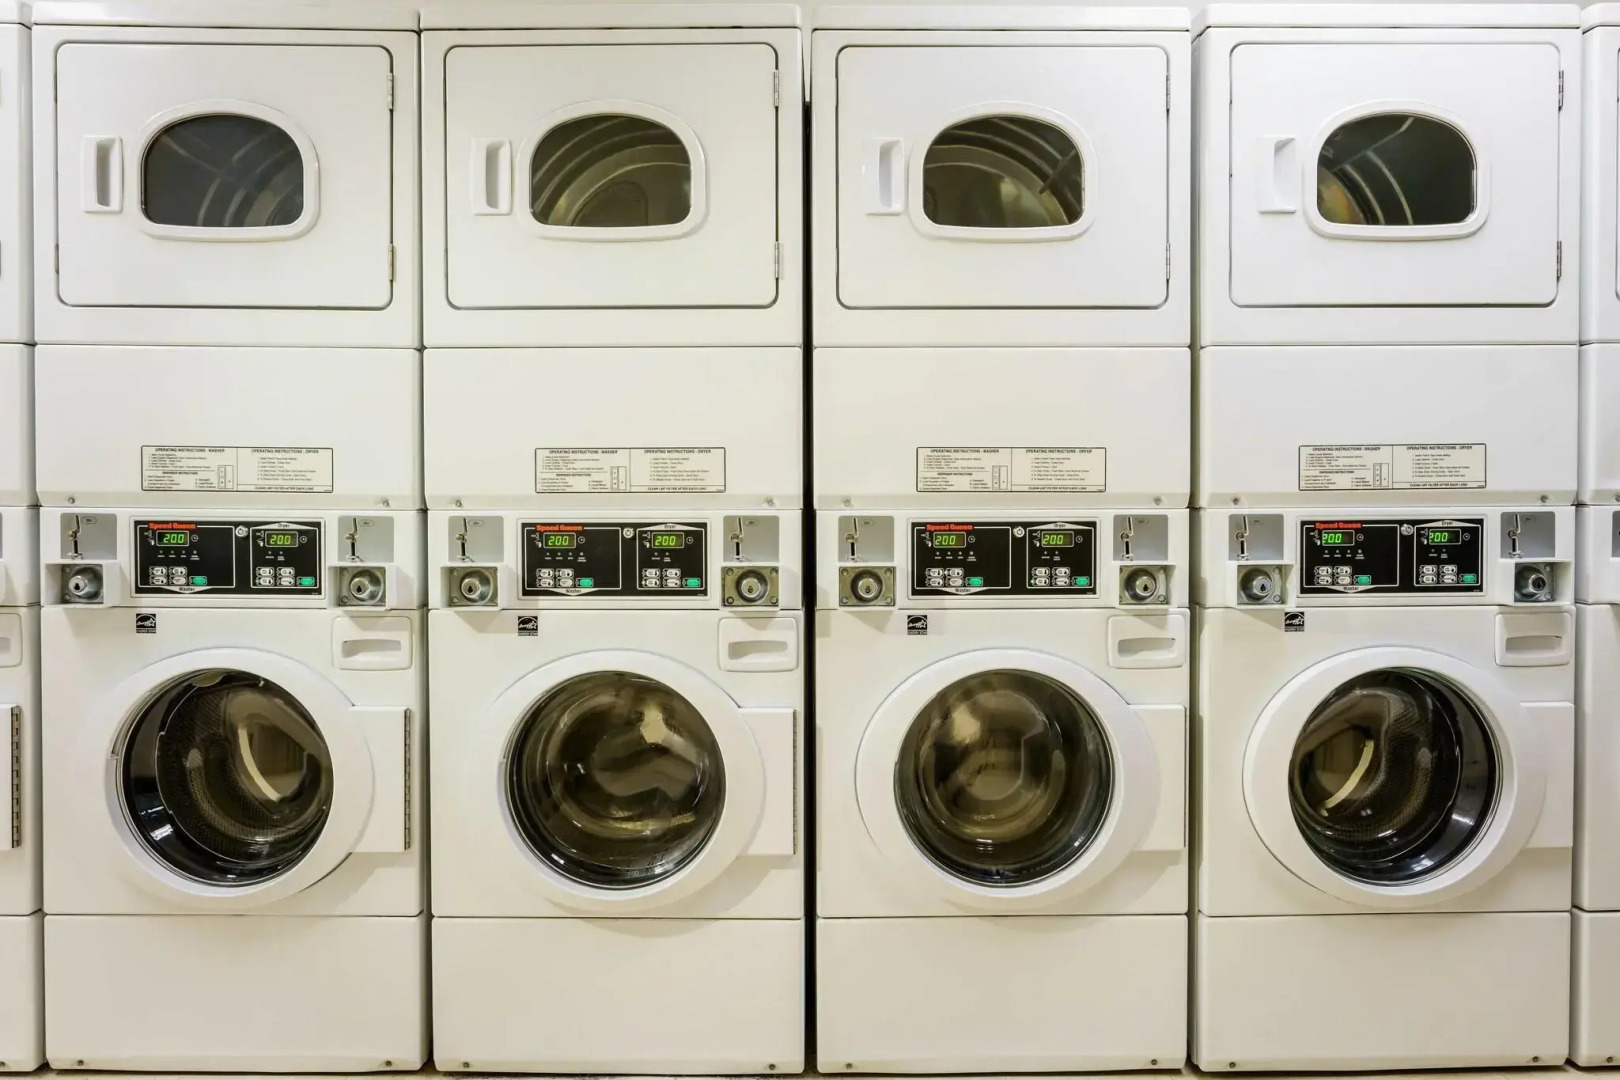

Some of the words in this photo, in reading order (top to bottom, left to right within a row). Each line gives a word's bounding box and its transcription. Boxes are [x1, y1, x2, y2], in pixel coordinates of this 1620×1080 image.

[163, 534, 184, 544] 200
[270, 535, 291, 545] 200
[548, 536, 569, 546] 200
[655, 536, 676, 546] 200
[935, 535, 956, 546] 200
[1043, 535, 1064, 545] 200
